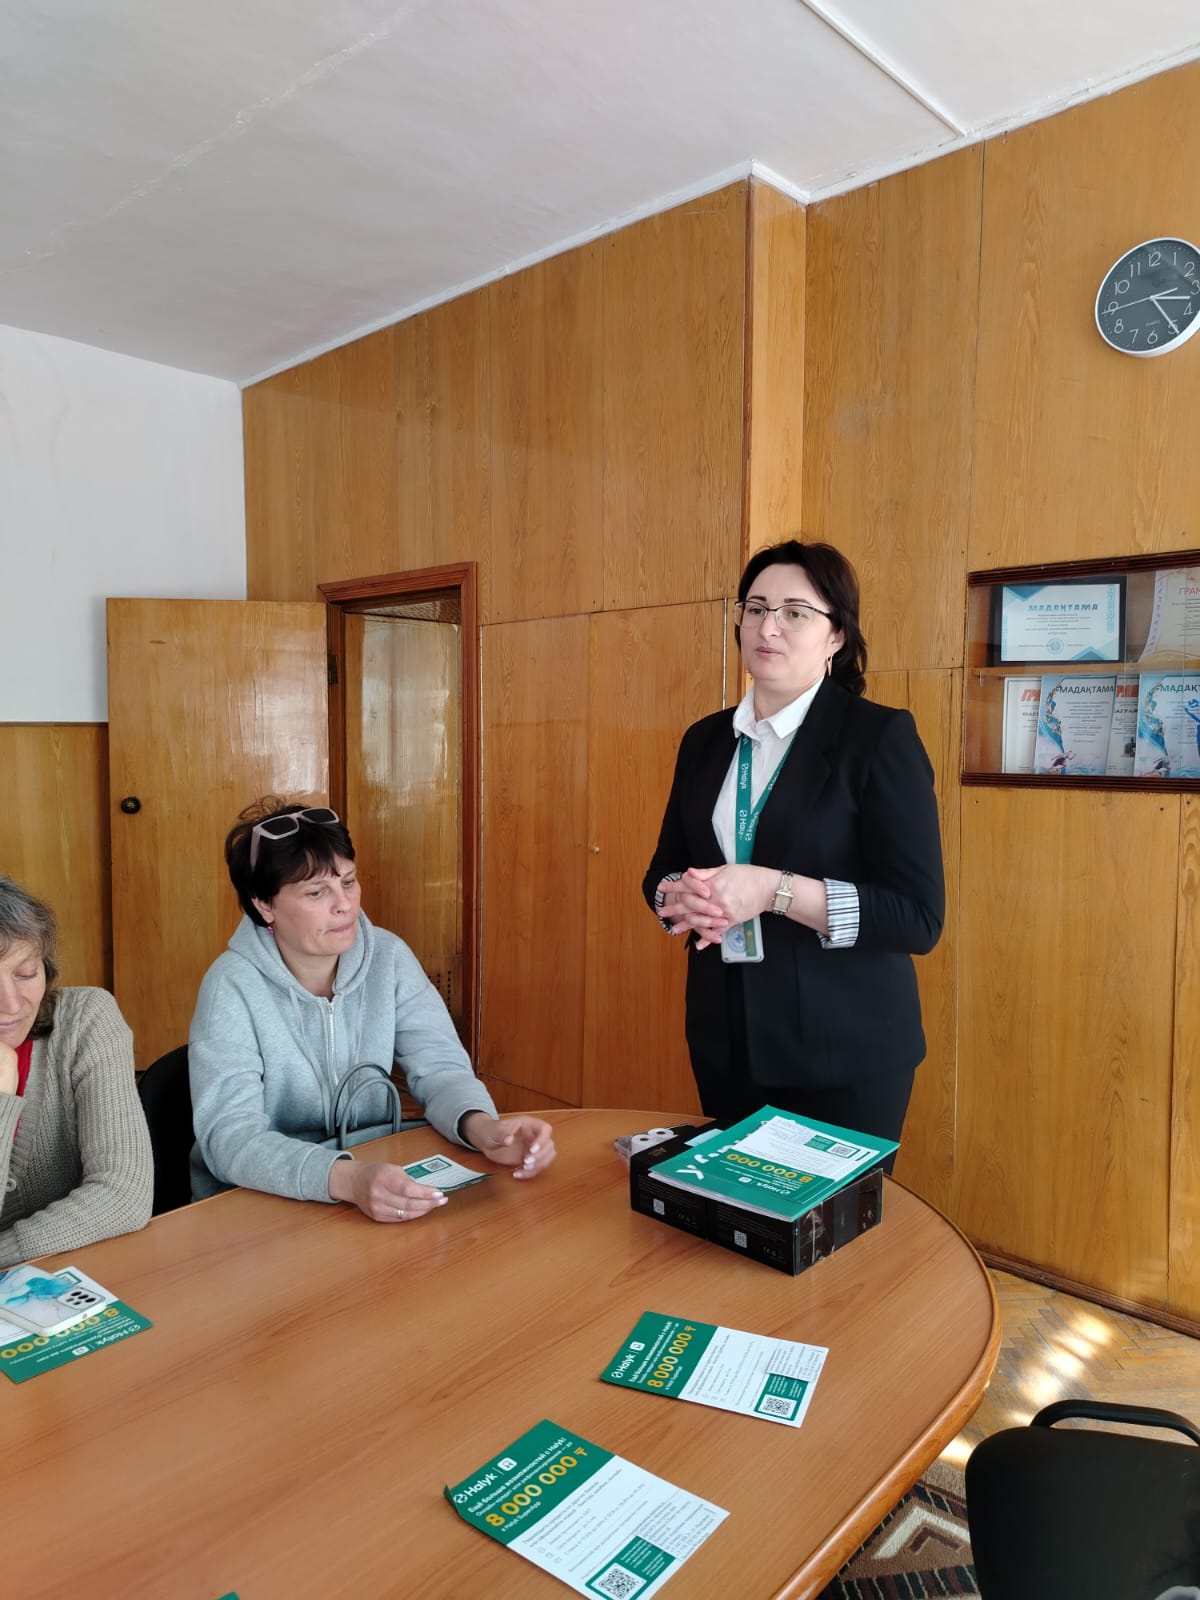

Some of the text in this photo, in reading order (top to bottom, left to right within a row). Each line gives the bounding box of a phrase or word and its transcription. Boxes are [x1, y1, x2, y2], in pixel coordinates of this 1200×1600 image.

[1148, 251, 1161, 267] 12
[1173, 252, 1177, 266] 1
[1130, 262, 1141, 278] 11
[1184, 261, 1195, 277] 2
[1114, 280, 1130, 295] 10
[1190, 279, 1200, 295] 3
[1108, 301, 1119, 316] 9
[1183, 302, 1193, 316] 4
[1113, 318, 1124, 334] 8
[1129, 328, 1139, 344] 7
[1147, 330, 1158, 344] 6
[726, 1153, 761, 1167] 000
[762, 1165, 798, 1179] 000
[95, 1330, 129, 1346] Halyk
[668, 1333, 692, 1355] 000
[0, 1337, 50, 1358] 000
[616, 1353, 636, 1372] Halyk
[653, 1356, 679, 1378] 000
[647, 1379, 664, 1388] 8
[464, 1472, 498, 1497] Halyk
[485, 1513, 505, 1526] 8
[501, 1484, 542, 1515] 000
[538, 1455, 578, 1485] 000
